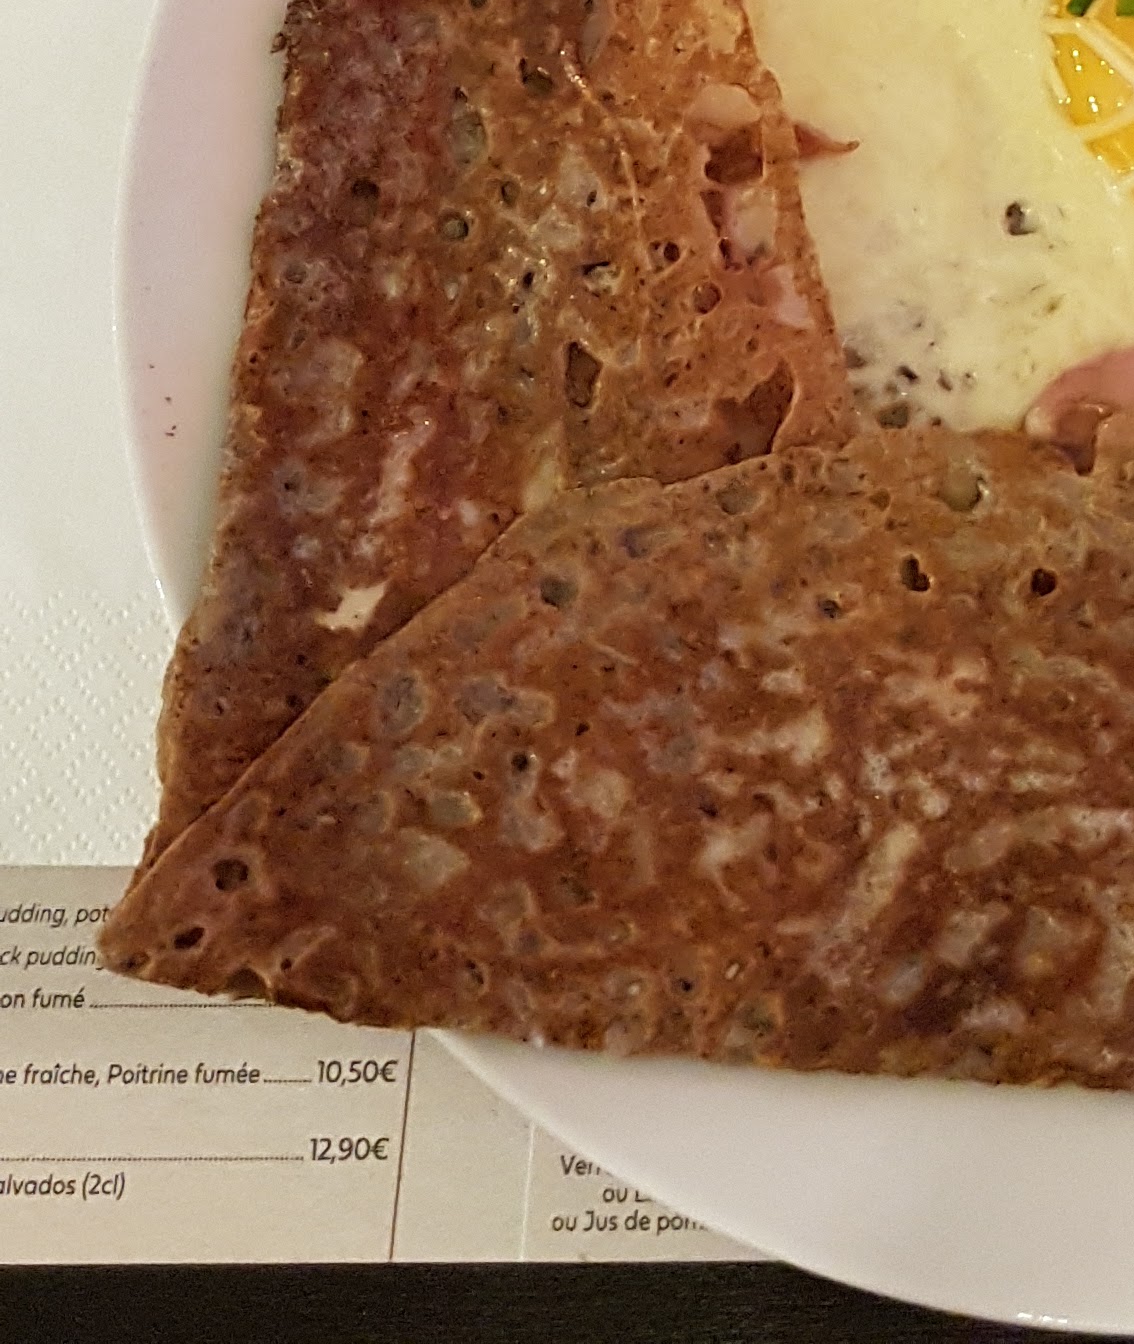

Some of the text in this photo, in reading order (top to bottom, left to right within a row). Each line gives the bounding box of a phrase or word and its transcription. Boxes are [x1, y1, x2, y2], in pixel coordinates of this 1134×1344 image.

[31, 987, 85, 1009] fumé
[24, 1060, 399, 1089] fraîche, Poitrine fumée 10,50€
[309, 1137, 390, 1165] 12,90€
[81, 1172, 126, 1201] (2cl)
[602, 1188, 628, 1203] ou
[552, 1210, 650, 1231] ou Jus de
